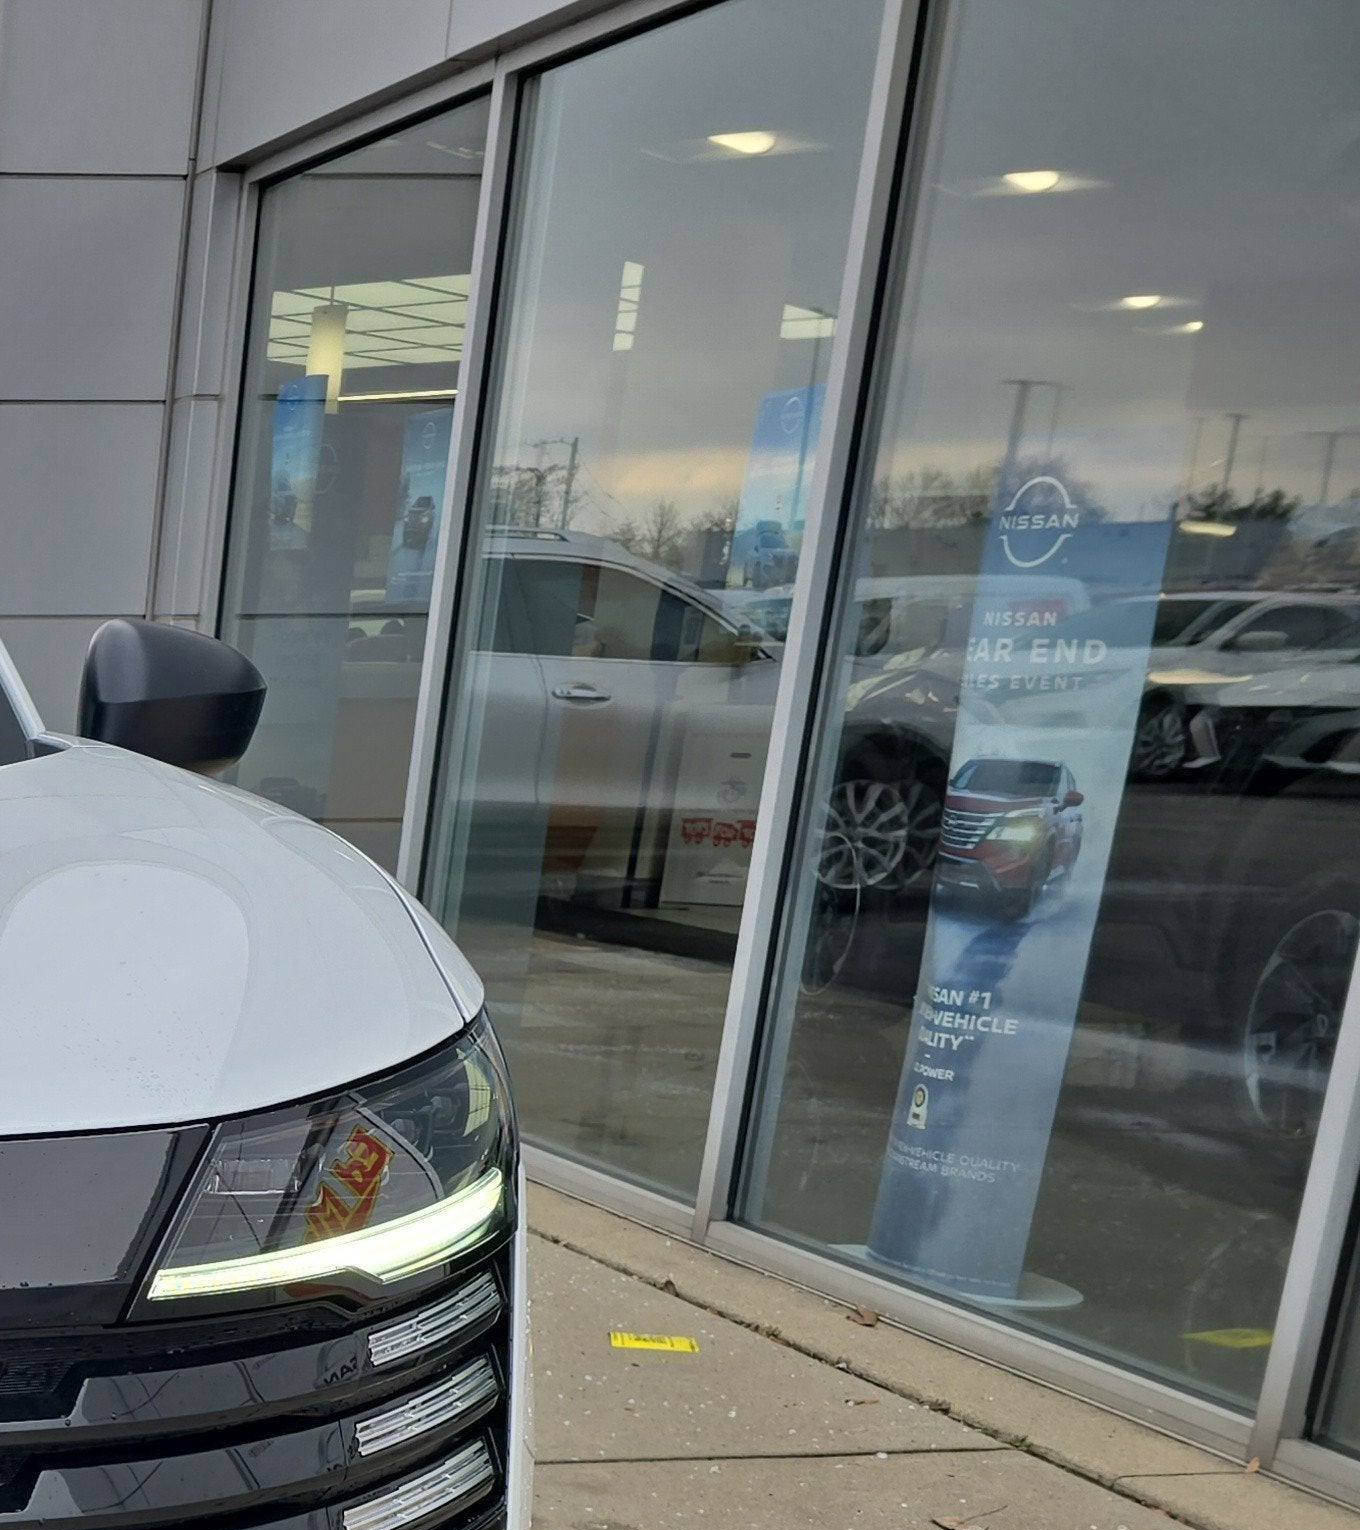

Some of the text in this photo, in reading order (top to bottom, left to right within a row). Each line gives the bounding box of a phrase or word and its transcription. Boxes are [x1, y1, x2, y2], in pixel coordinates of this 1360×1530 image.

[998, 511, 1080, 531] NISSAN
[983, 610, 1058, 627] NISSAN
[1028, 638, 1108, 665] END
[1009, 673, 1084, 691] EVENT
[968, 990, 993, 1010] #1
[959, 1154, 1019, 1173] QUALITY
[940, 1164, 996, 1184] BRANDS
